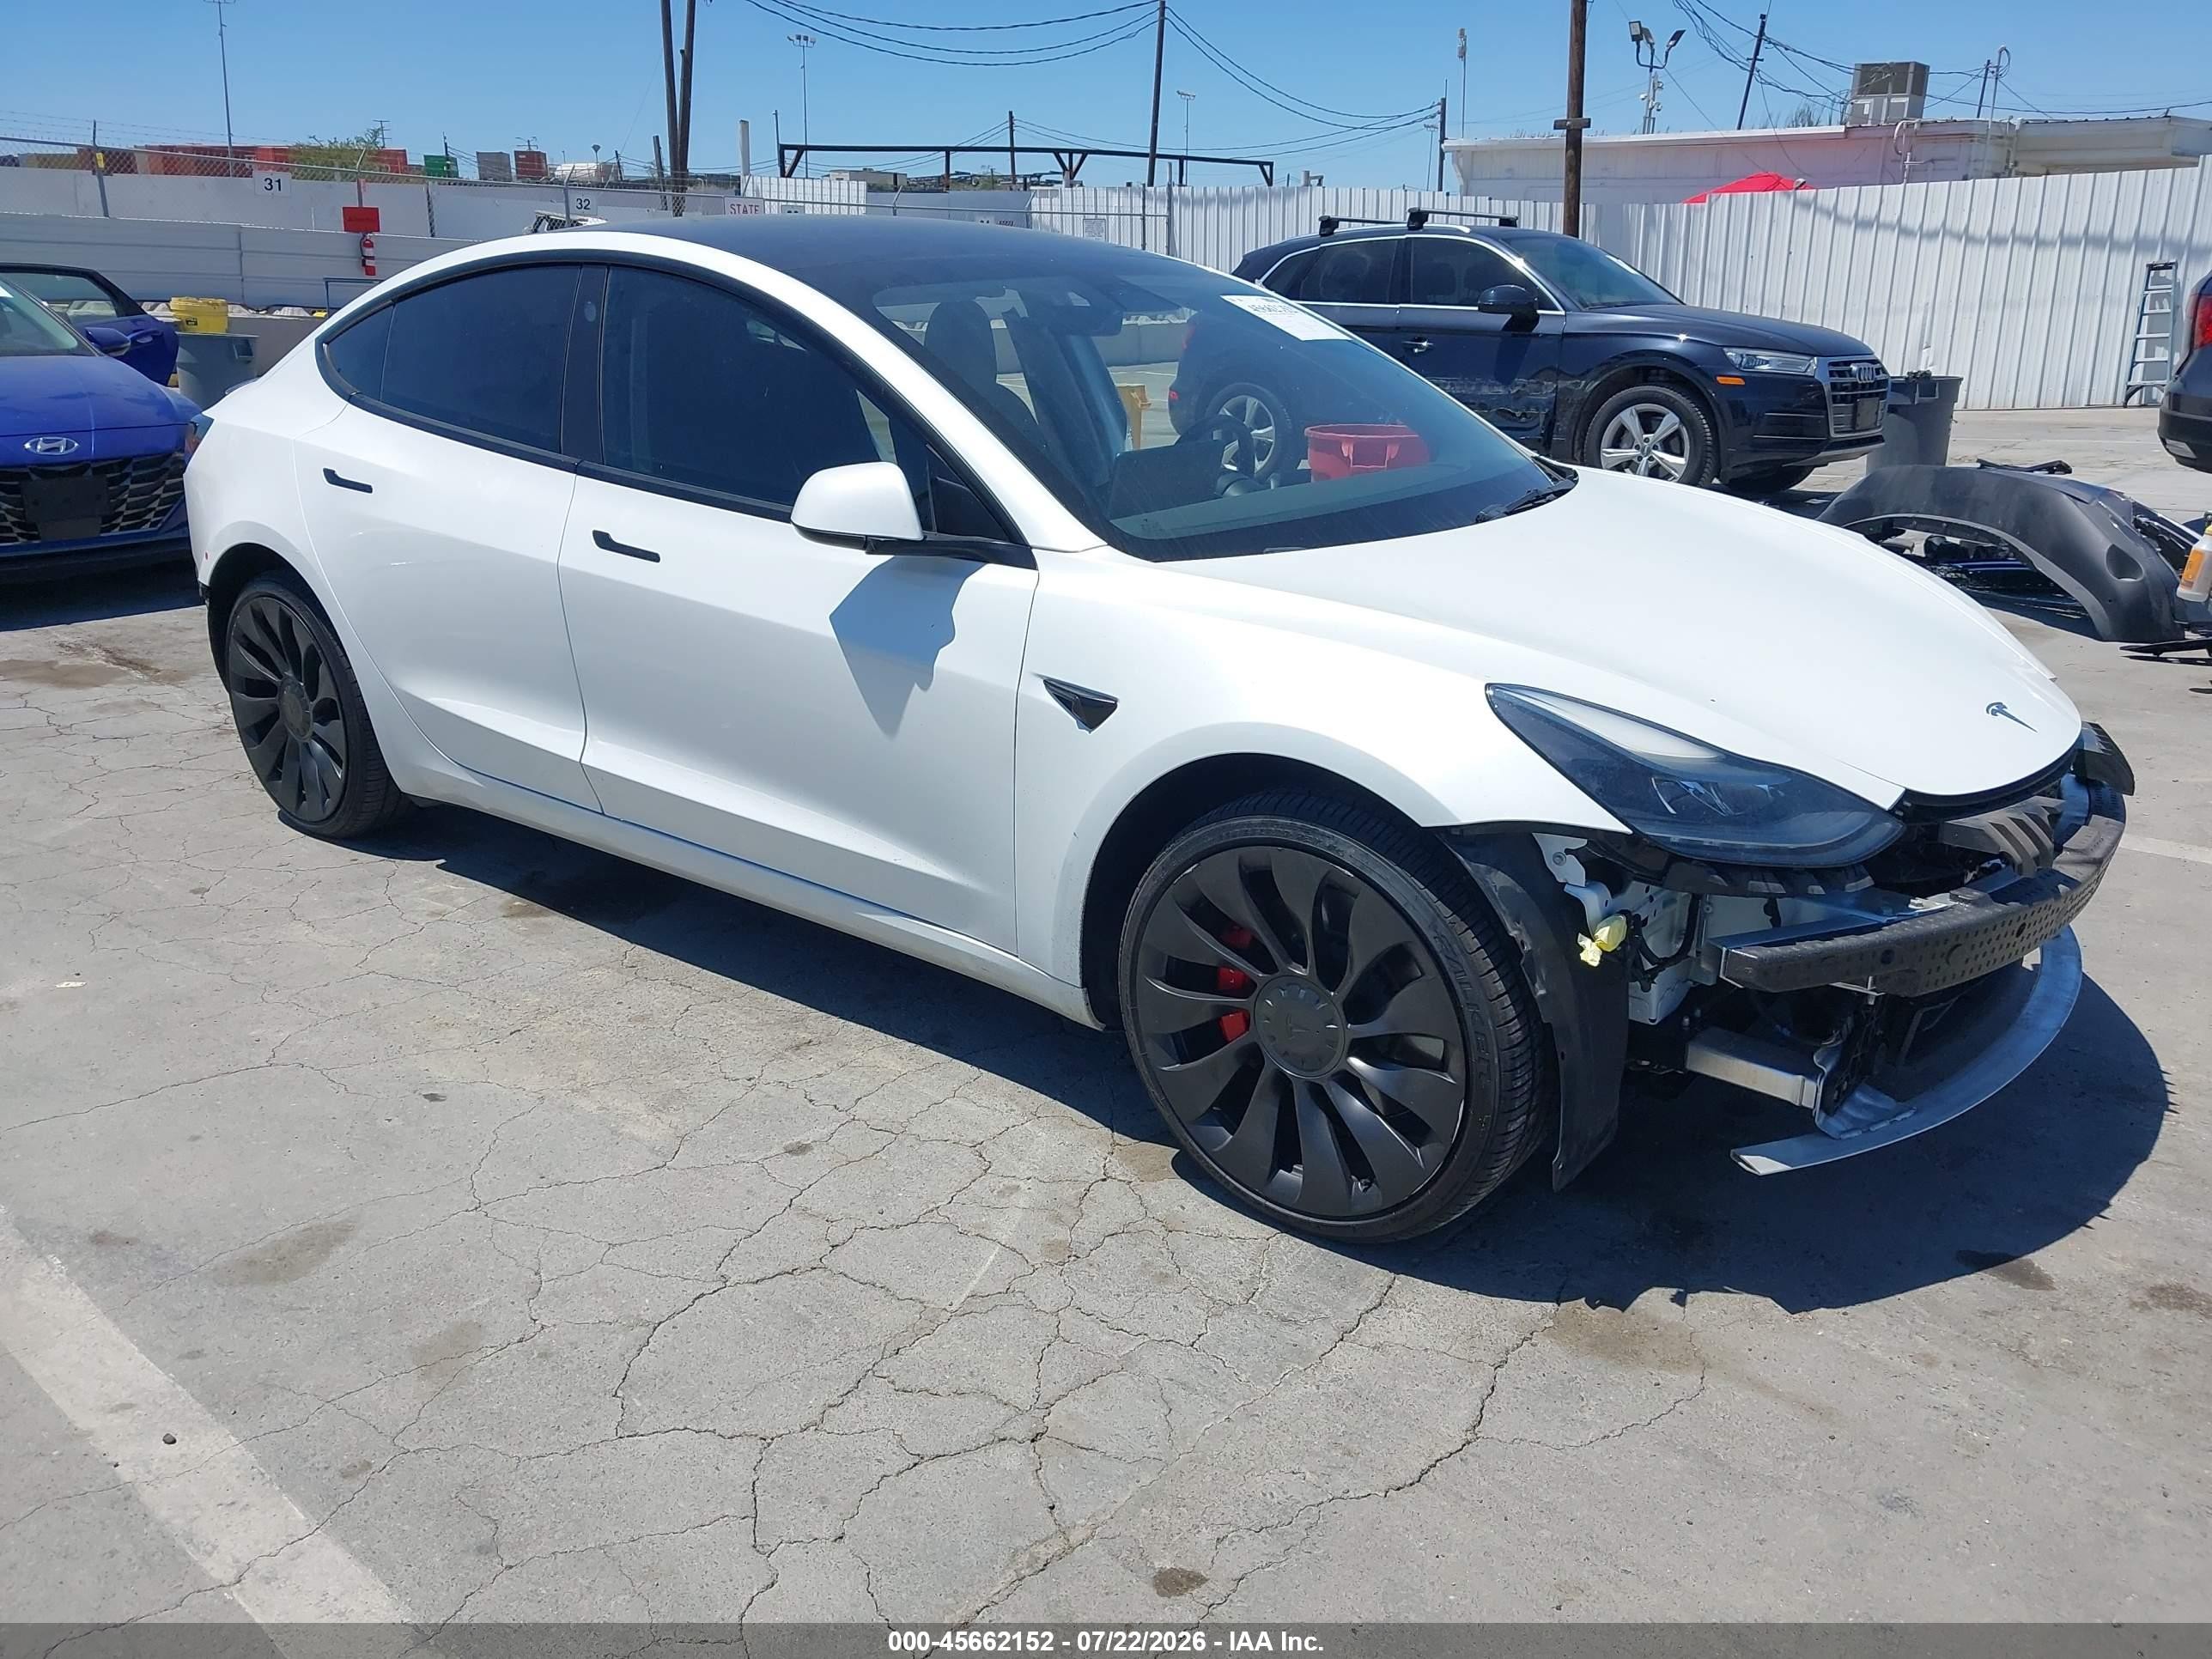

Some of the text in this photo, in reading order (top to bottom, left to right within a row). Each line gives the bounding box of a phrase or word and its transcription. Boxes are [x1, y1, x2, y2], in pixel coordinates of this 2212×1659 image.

[264, 177, 282, 191] 31
[575, 198, 591, 210] 32
[730, 204, 760, 215] STATE
